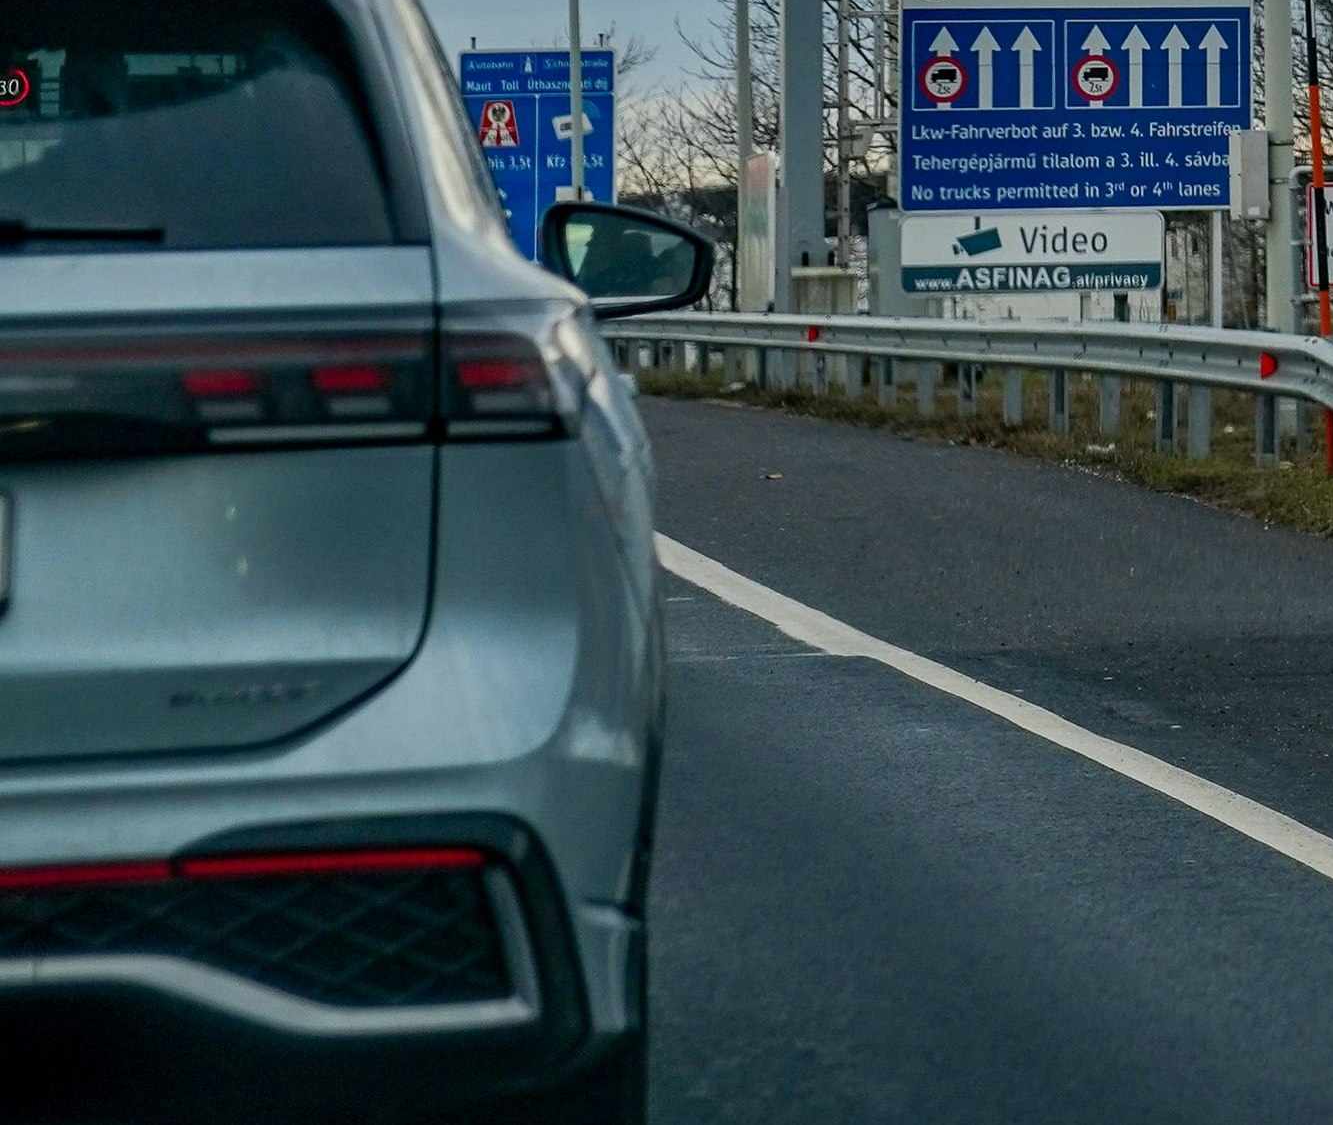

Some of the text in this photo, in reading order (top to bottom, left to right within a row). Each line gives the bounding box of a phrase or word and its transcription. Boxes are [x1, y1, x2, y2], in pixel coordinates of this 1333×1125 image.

[466, 81, 492, 91] Maut
[501, 80, 519, 91] Toll
[911, 124, 1038, 140] Lkw-Fahrverbot
[1042, 123, 1069, 138] auf
[1072, 123, 1086, 138] 3.
[1091, 123, 1125, 138] bzw.
[1130, 123, 1144, 137] 4.
[912, 152, 1037, 174] Tehergépjármű
[1042, 152, 1100, 168] tilalom
[1105, 155, 1115, 168] a
[1121, 152, 1134, 167] 3.
[1139, 151, 1159, 167] ill.
[1164, 152, 1179, 167] 4.
[911, 184, 934, 200] No
[939, 183, 991, 200] trucks
[997, 181, 1079, 203] permitted
[1085, 181, 1100, 198] in
[1130, 183, 1147, 197] or
[1178, 181, 1221, 197] lanes
[1020, 225, 1109, 255] Video
